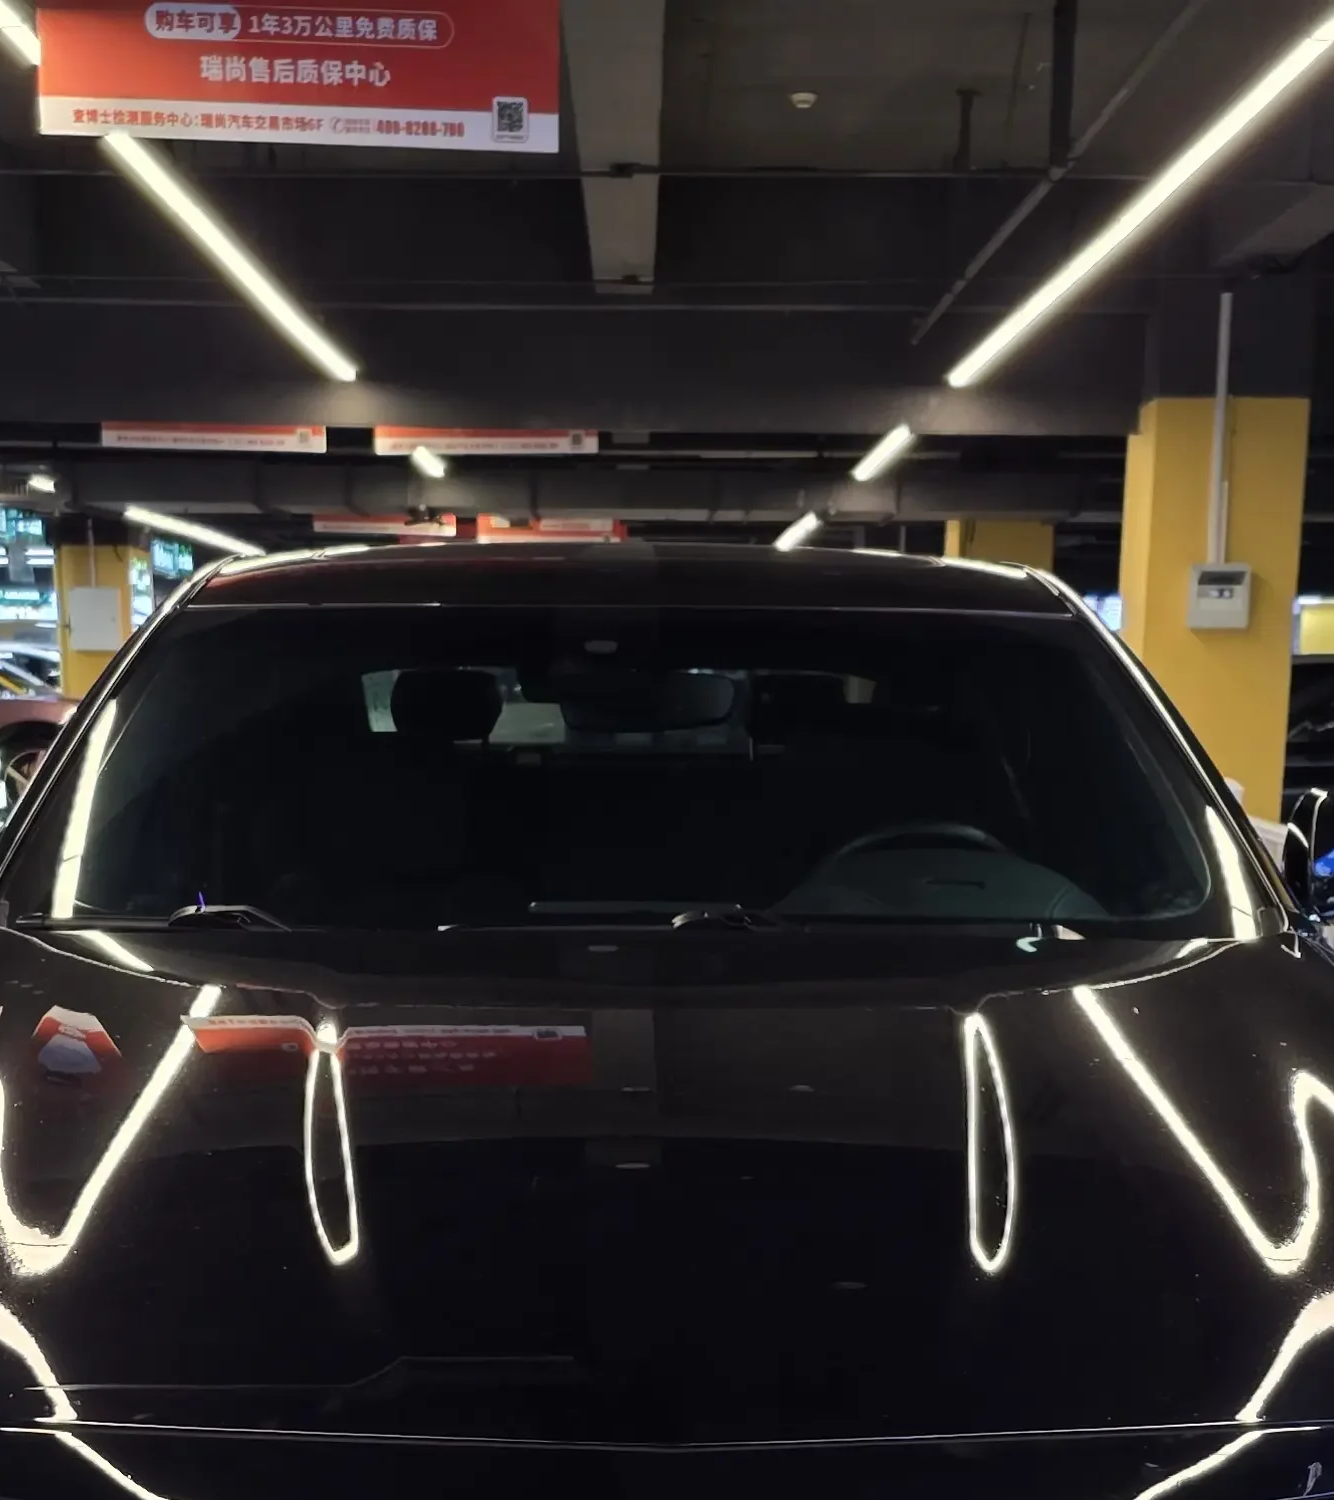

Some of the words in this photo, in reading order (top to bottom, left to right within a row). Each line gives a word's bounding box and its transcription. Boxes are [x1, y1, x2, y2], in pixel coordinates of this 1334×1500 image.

[155, 9, 238, 34] 购车可享
[249, 13, 438, 41] 1年3万公里免费质保
[200, 54, 391, 87] 瑞尚售后质保中心
